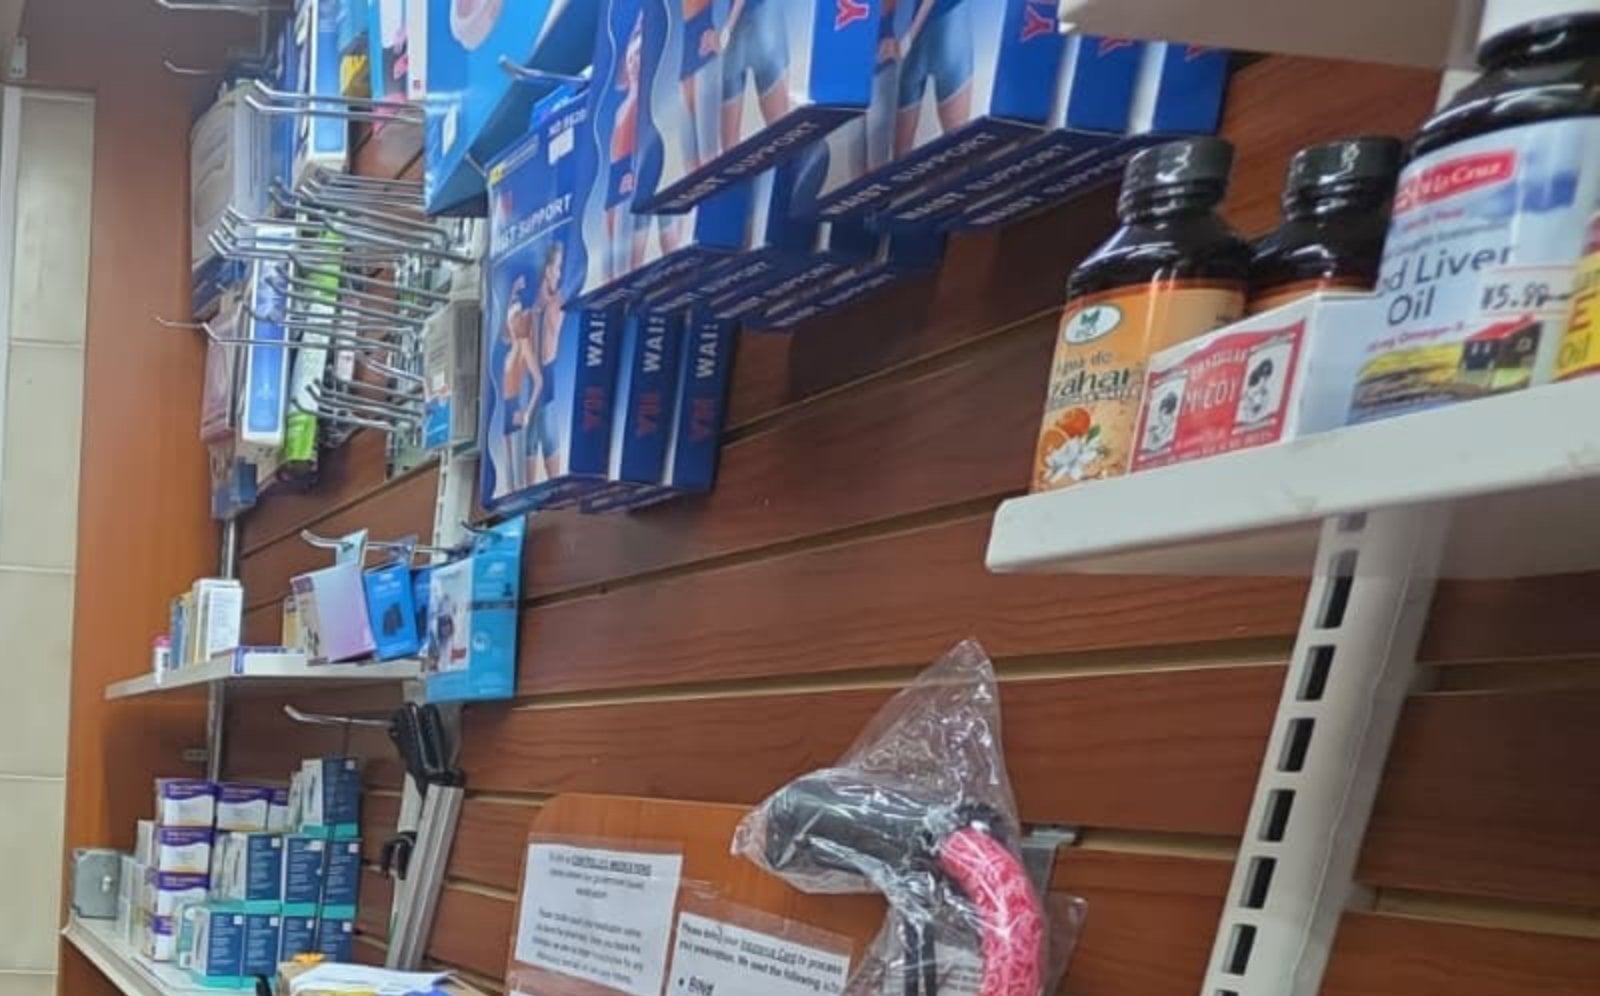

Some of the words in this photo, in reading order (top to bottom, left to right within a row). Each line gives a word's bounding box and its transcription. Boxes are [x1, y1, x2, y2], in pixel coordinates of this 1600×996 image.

[1415, 246, 1512, 284] Liver
[1386, 286, 1437, 328] Oil
[1050, 366, 1131, 400] zahar
